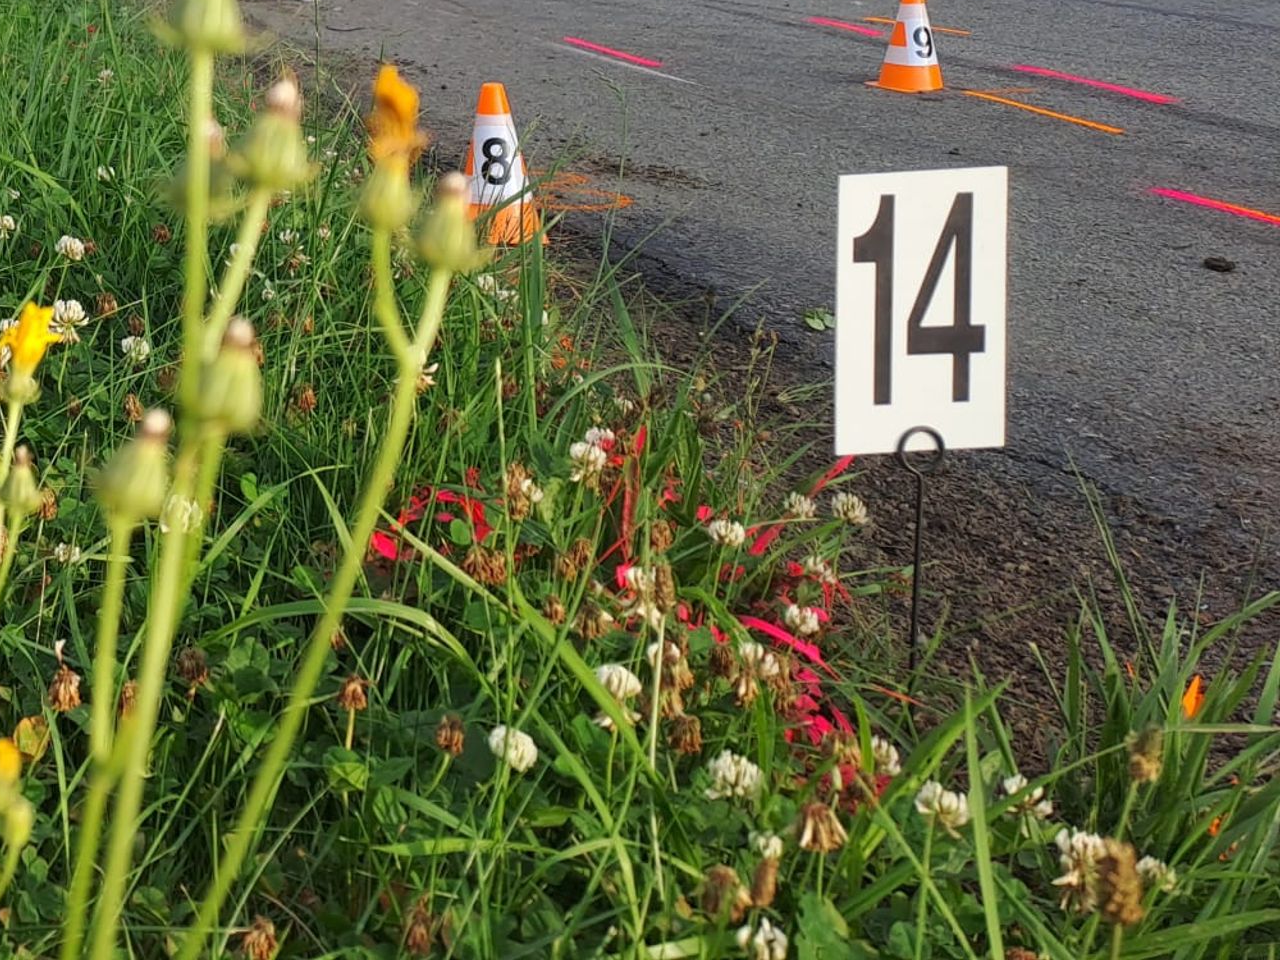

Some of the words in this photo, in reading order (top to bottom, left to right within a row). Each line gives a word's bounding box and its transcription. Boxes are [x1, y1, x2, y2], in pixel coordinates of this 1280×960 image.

[913, 26, 933, 58] 9
[481, 137, 511, 186] 8
[852, 191, 986, 406] 14
